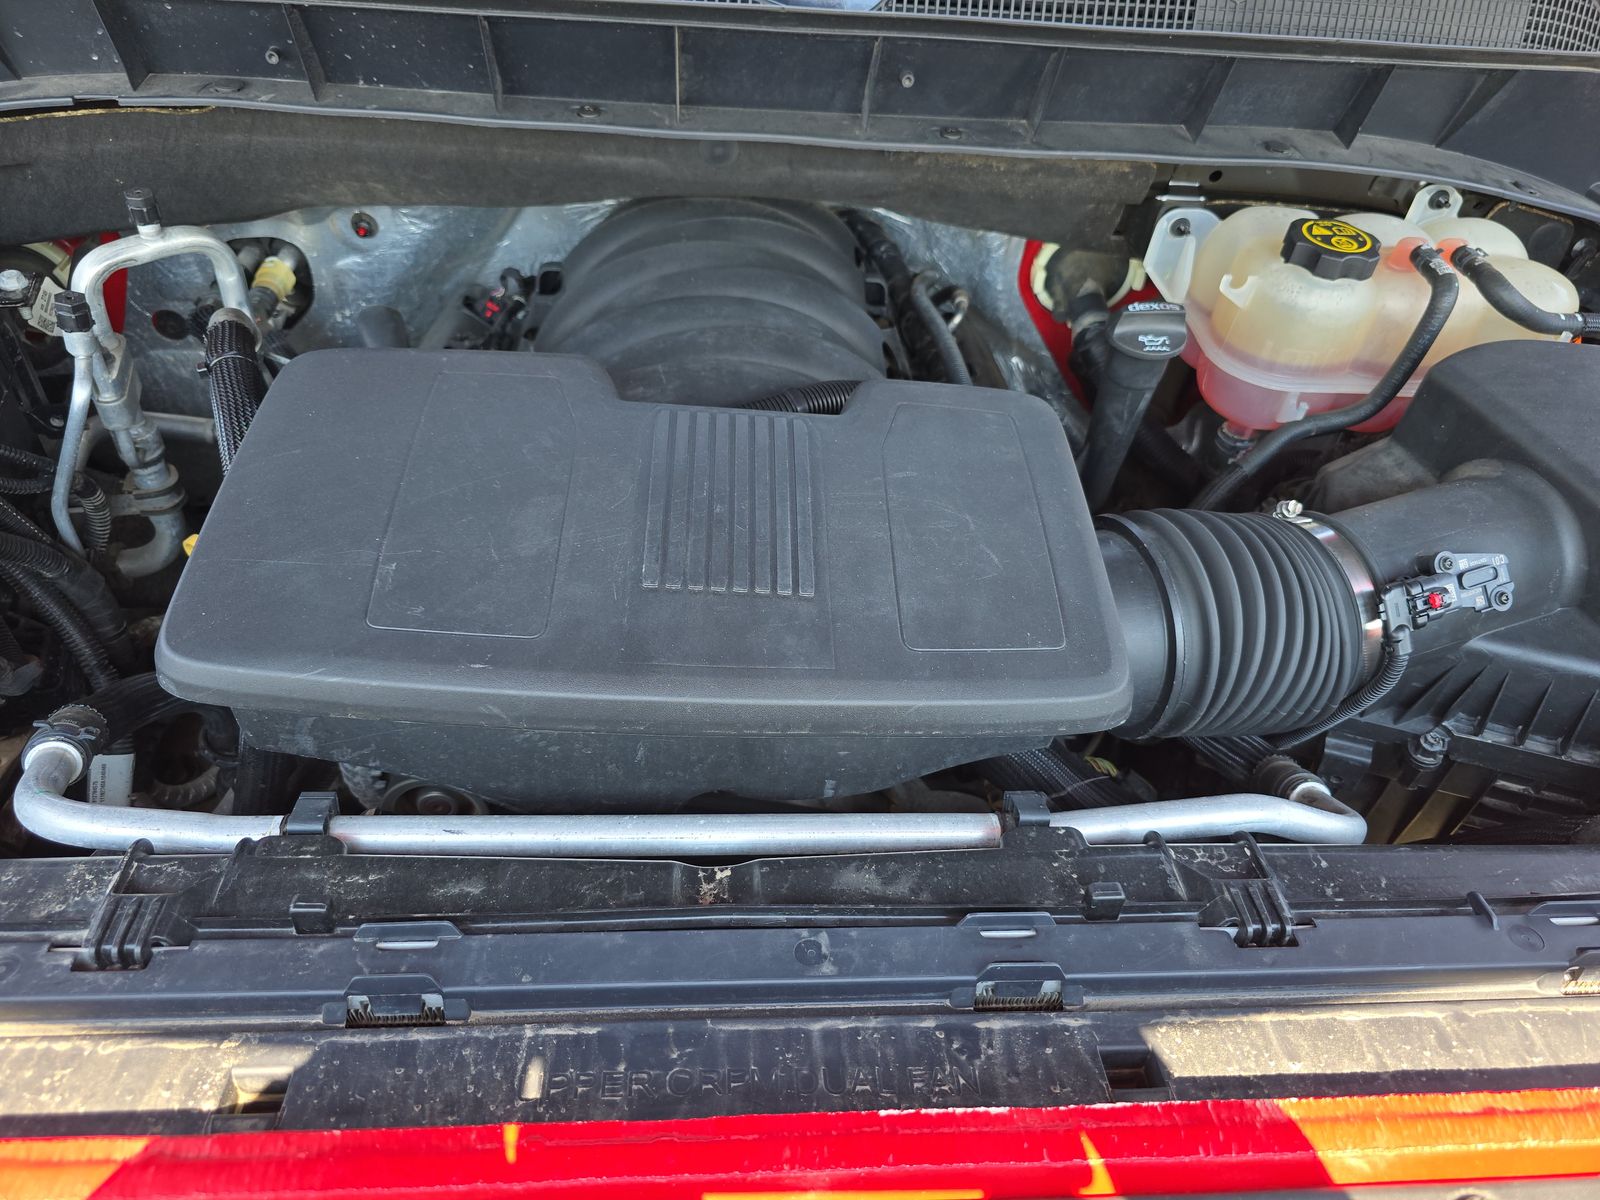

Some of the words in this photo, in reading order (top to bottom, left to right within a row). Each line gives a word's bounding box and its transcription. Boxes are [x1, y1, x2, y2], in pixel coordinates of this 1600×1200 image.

[1127, 301, 1181, 312] dexos
[519, 1066, 657, 1101] UPPER
[795, 1066, 898, 1098] DUAL
[906, 1064, 982, 1098] FAN
